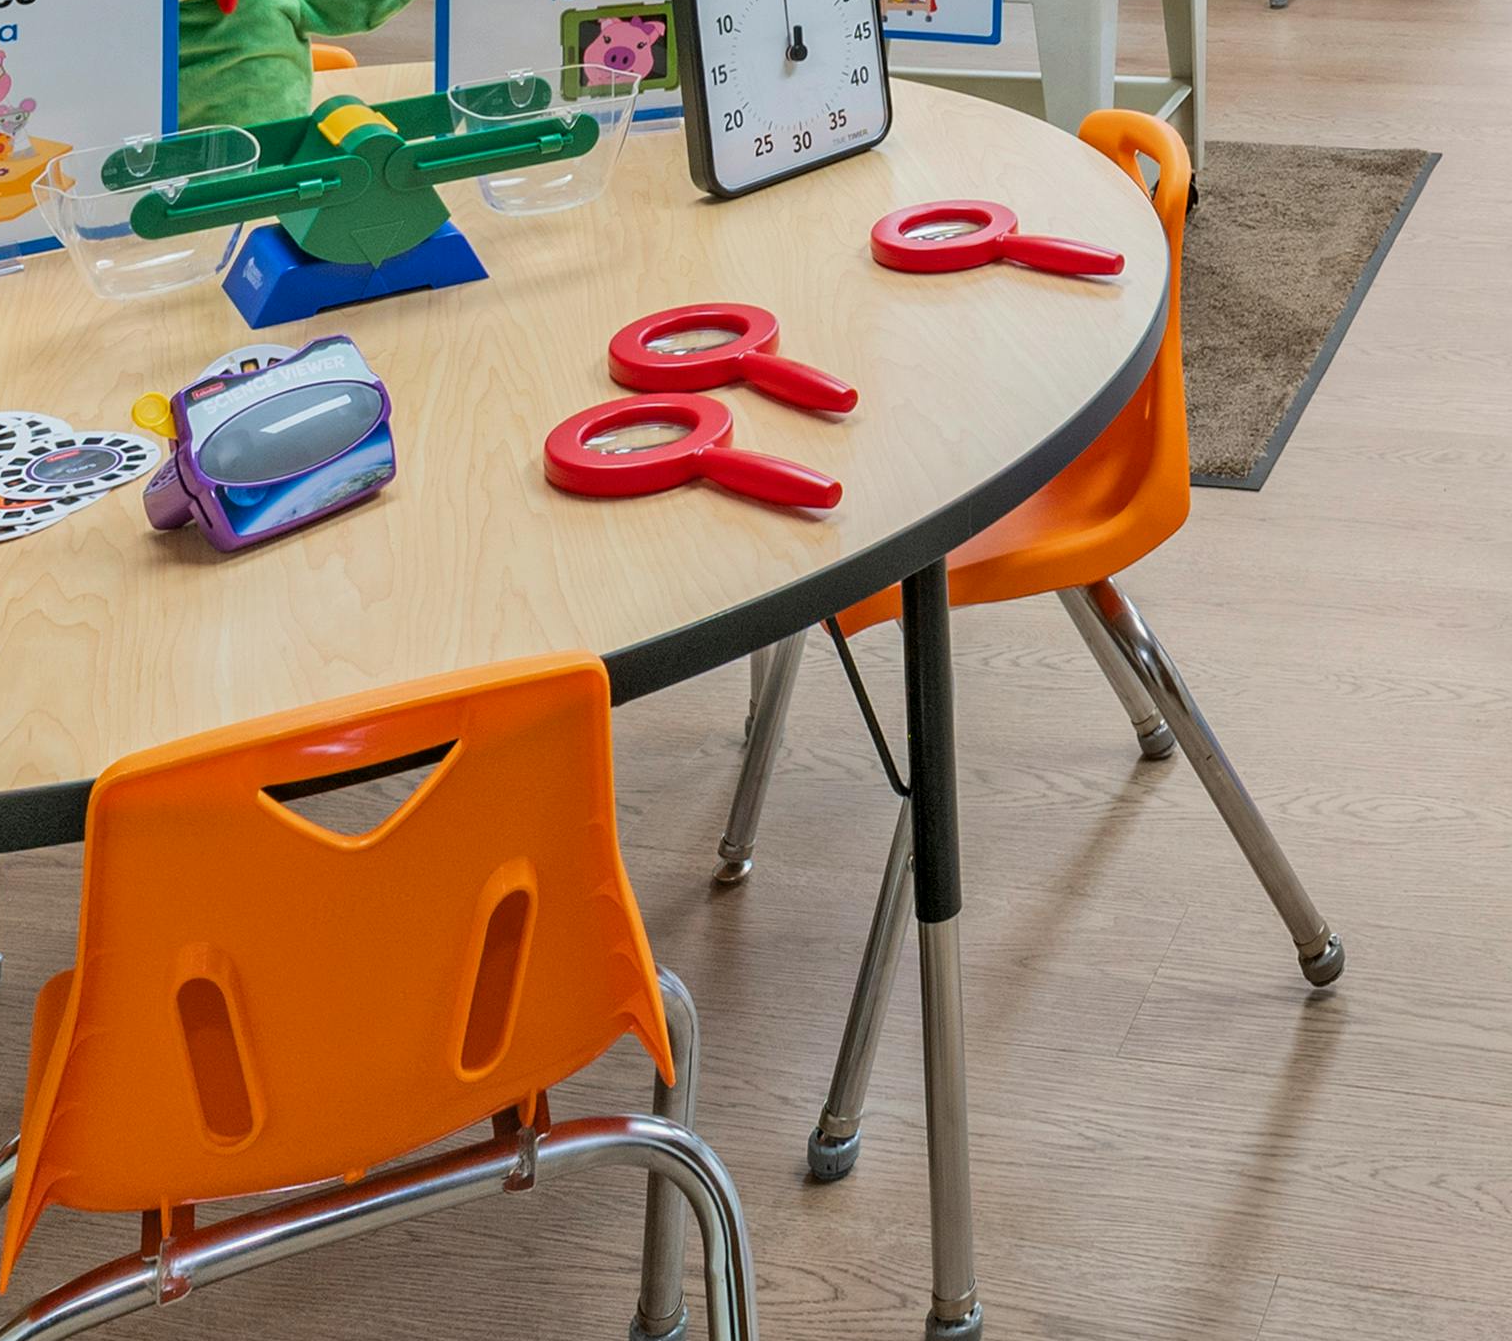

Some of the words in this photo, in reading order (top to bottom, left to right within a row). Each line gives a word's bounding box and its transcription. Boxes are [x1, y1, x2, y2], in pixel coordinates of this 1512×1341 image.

[716, 14, 733, 36] 10
[853, 21, 872, 41] 45
[711, 64, 728, 86] 15
[850, 66, 869, 87] 40
[724, 110, 744, 132] 20
[828, 109, 847, 131] 35
[754, 134, 774, 157] 25
[792, 131, 812, 153] 30
[201, 374, 276, 415] SCIENCE
[277, 355, 345, 381] VIEWER
